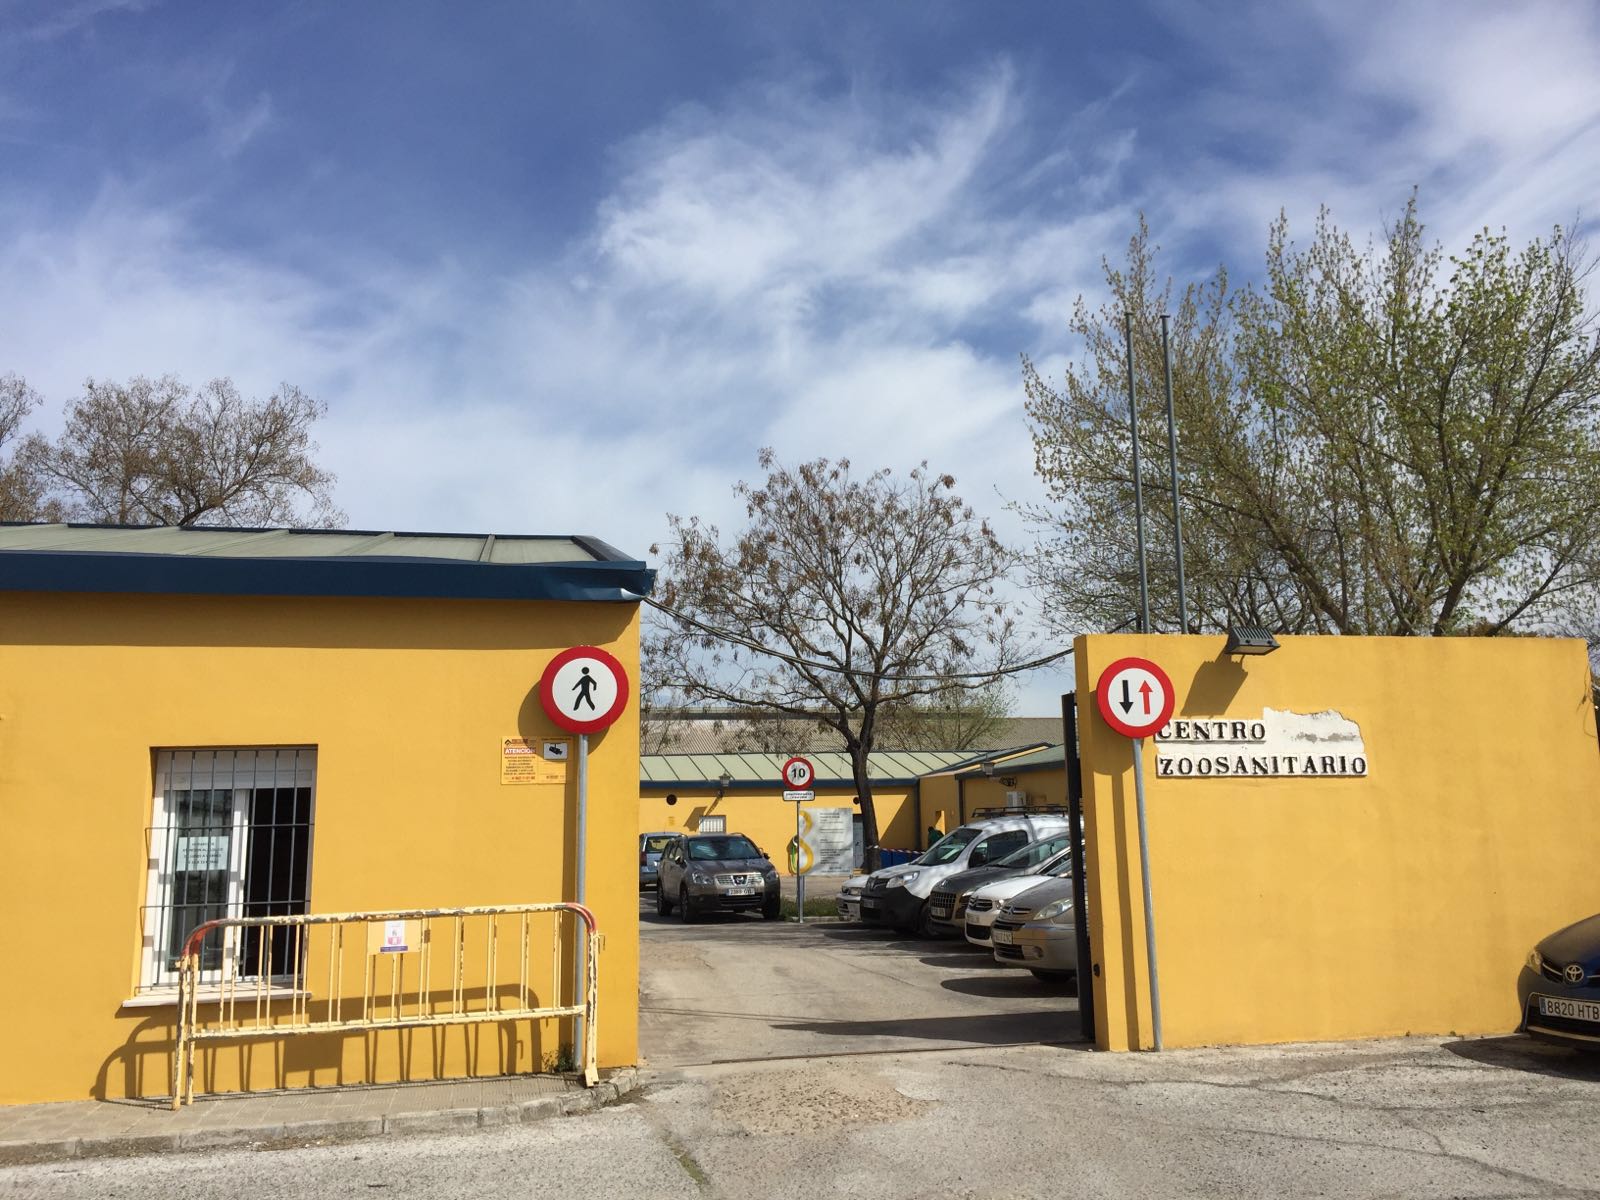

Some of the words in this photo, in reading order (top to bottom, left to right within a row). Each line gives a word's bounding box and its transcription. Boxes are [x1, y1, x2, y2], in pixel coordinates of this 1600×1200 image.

[1157, 721, 1266, 740] CENTRO
[791, 768, 806, 778] 10
[1159, 755, 1367, 775] ZOOSANITARIO
[1547, 1000, 1575, 1017] 8820
[1577, 1003, 1600, 1020] HTB
